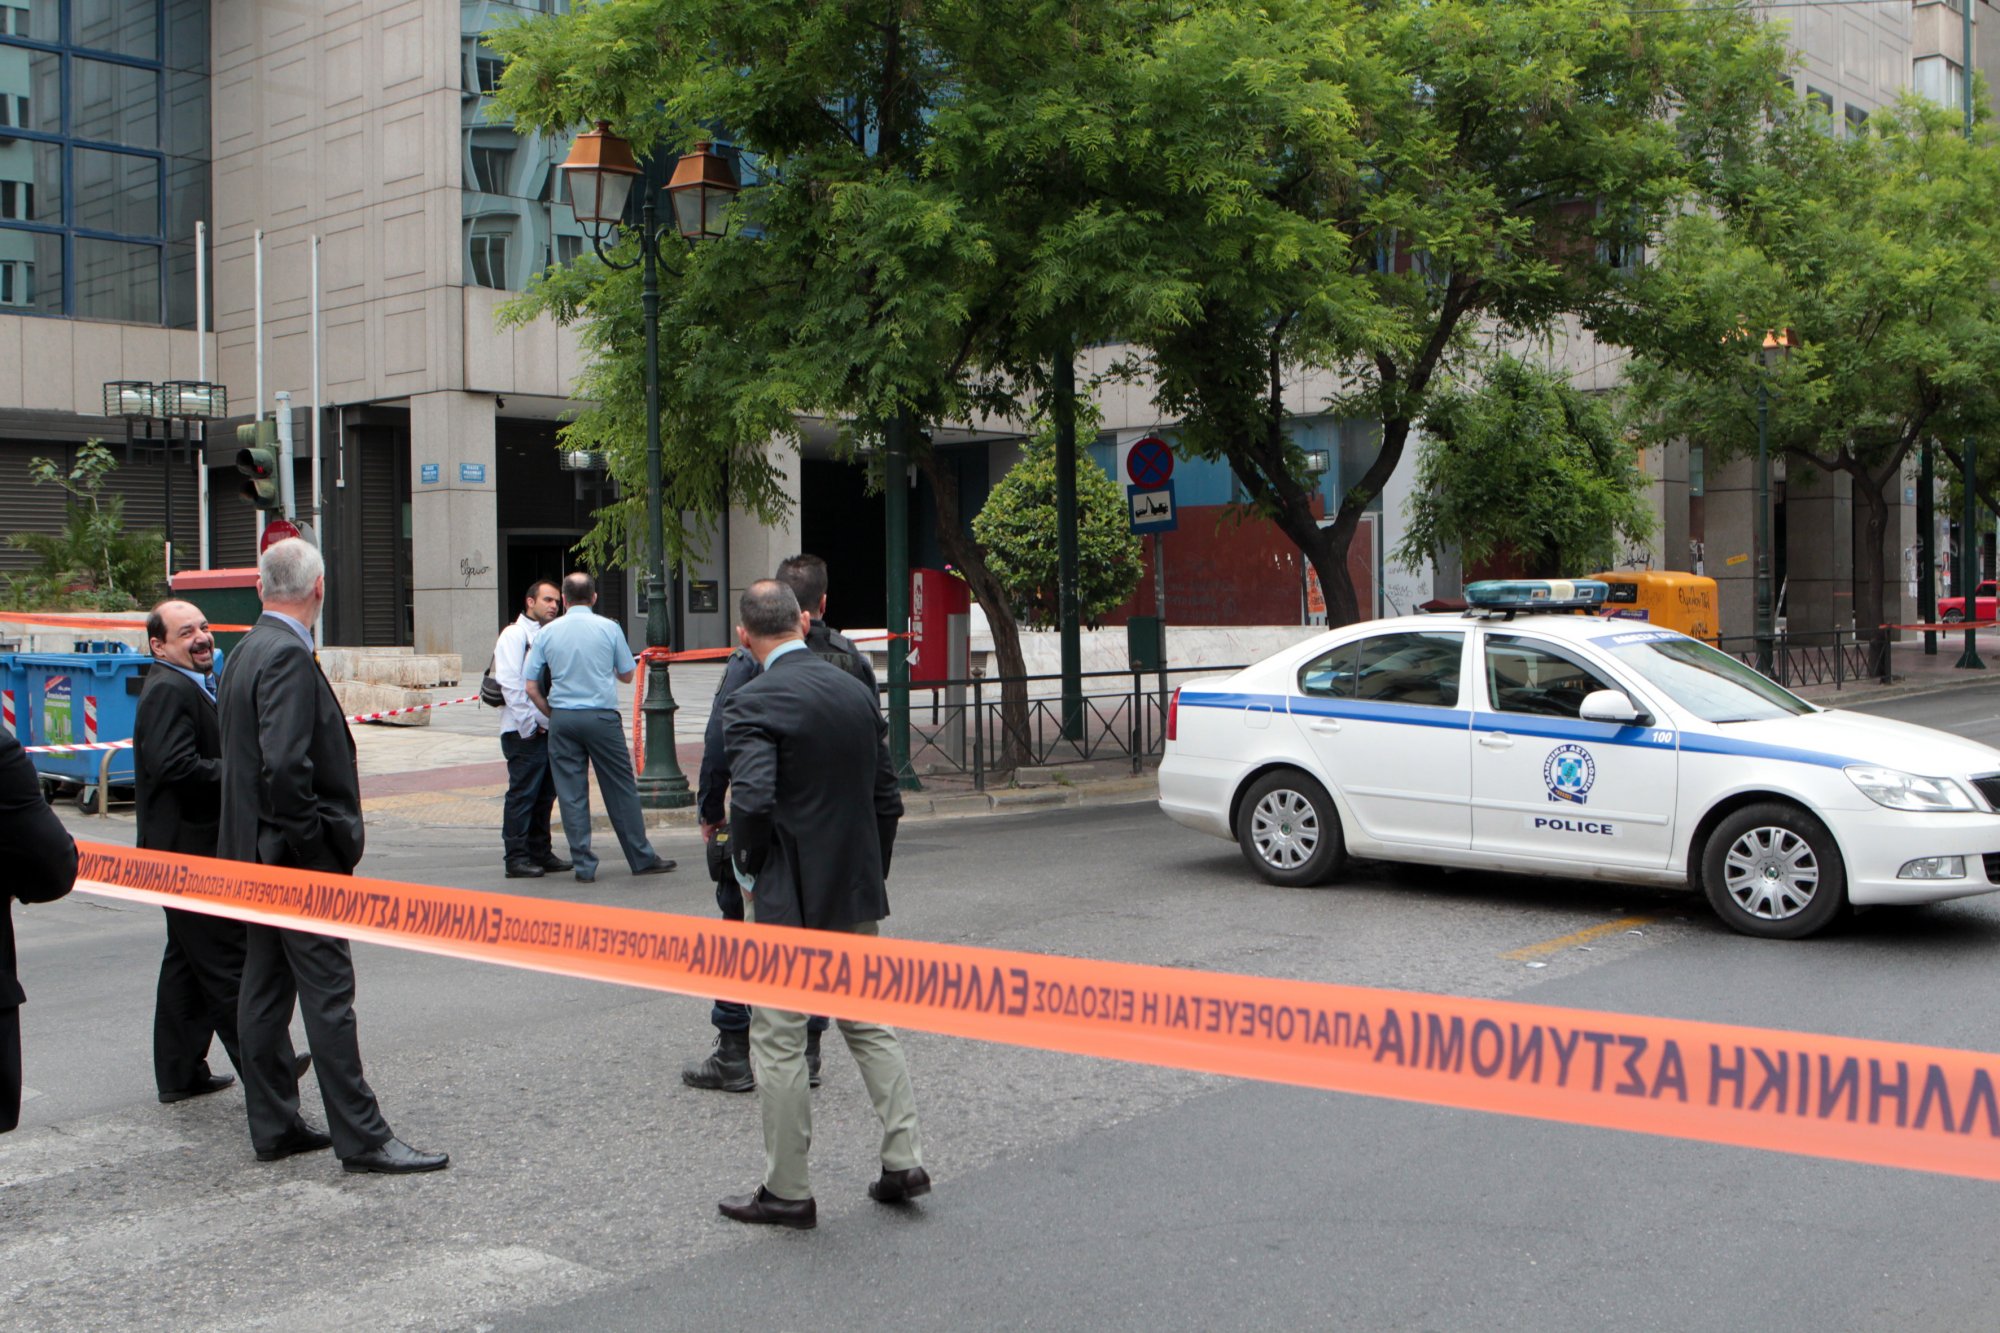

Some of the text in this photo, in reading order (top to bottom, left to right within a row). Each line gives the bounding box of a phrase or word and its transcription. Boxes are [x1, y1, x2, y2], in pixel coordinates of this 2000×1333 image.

[1652, 730, 1673, 743] 100
[1568, 744, 1596, 792] ΑΣΤΥΝΟΜΙΑ
[1534, 817, 1614, 836] POLICE
